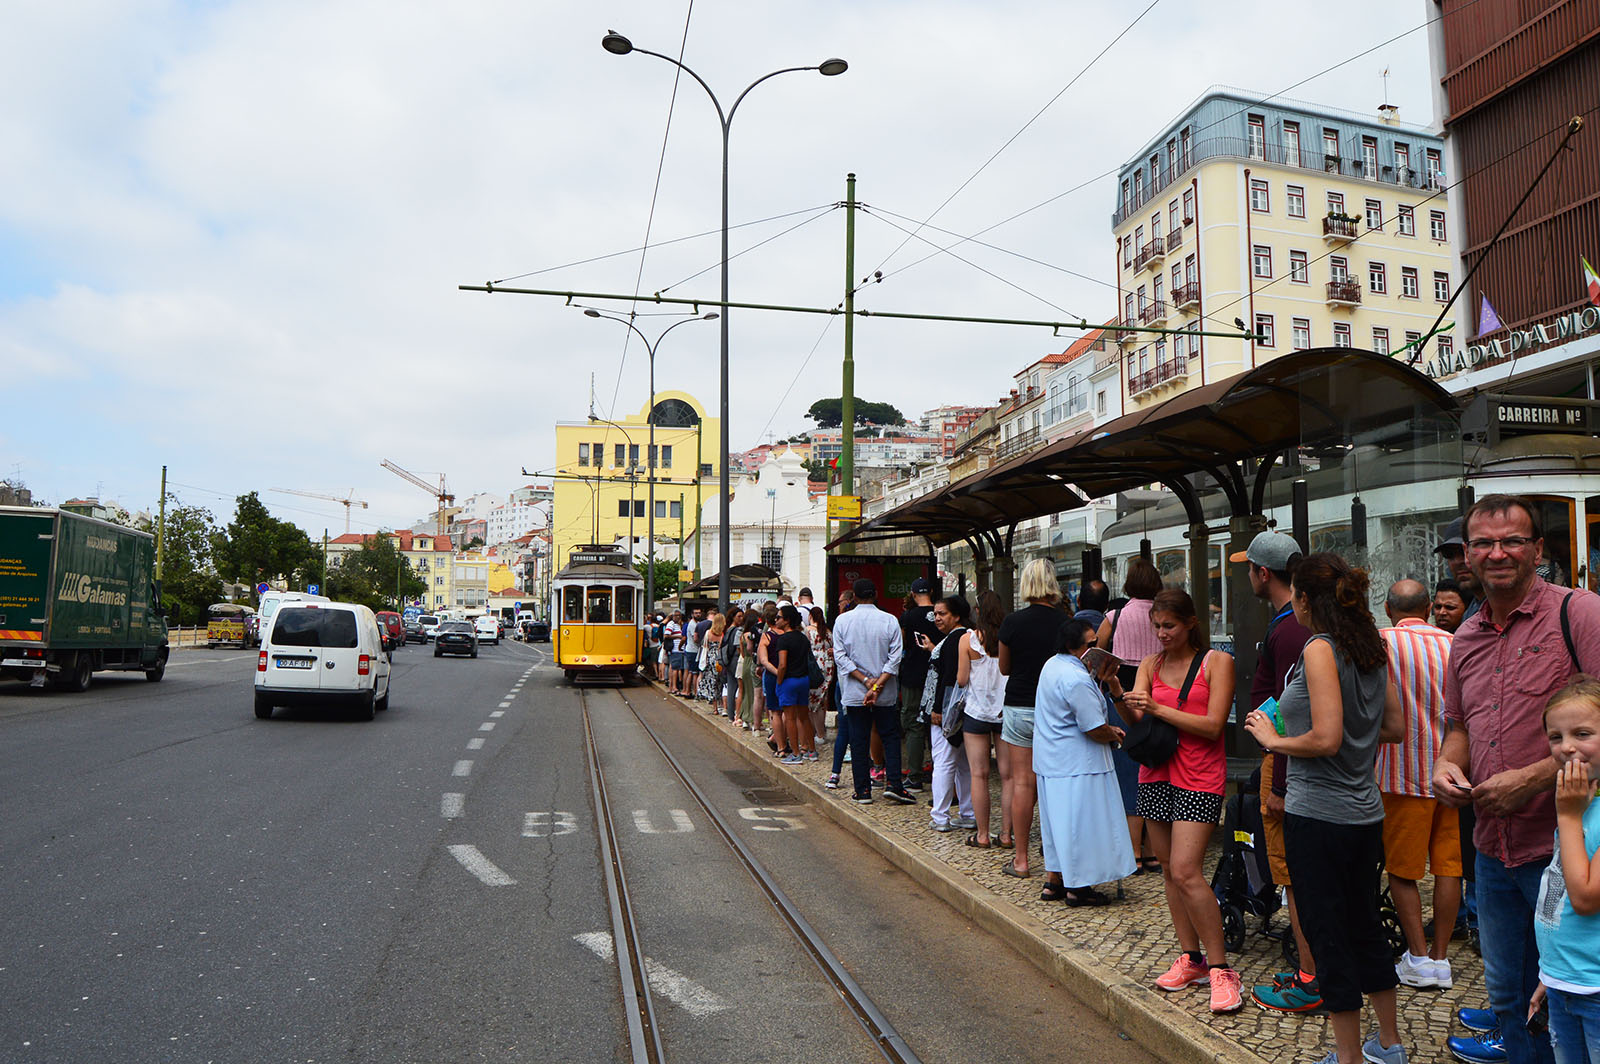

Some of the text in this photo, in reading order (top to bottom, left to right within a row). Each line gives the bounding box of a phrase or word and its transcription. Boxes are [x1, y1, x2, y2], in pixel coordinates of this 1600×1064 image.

[1510, 323, 1550, 352] DA
[1498, 405, 1581, 425] CARREIRA Nº
[77, 574, 127, 607] Galamas
[310, 585, 318, 595] P
[520, 806, 808, 839] BUS
